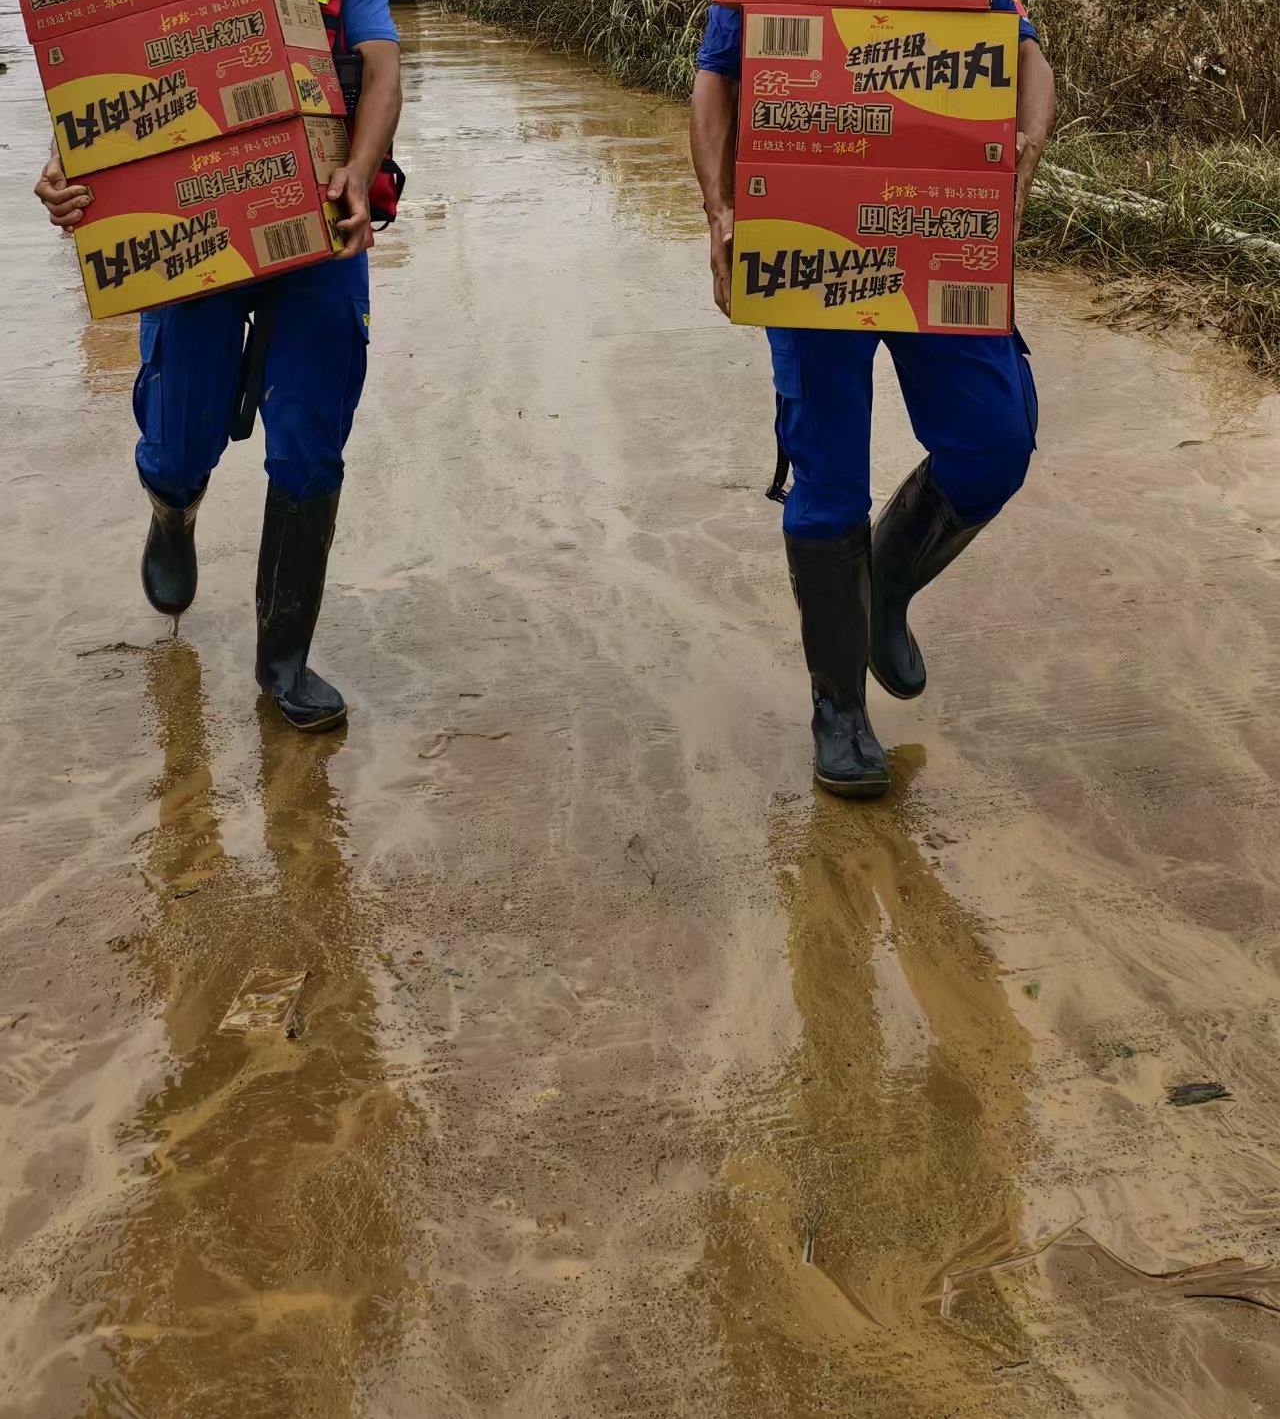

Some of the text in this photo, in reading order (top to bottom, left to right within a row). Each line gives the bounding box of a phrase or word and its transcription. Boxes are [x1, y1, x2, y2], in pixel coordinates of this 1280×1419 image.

[145, 11, 265, 68] 红烧牛肉面
[221, 41, 273, 71] 统一
[846, 32, 926, 67] 全新升级
[753, 70, 817, 96] 统一
[134, 85, 198, 140] 全新升级
[752, 102, 893, 135] 红烧牛肉面
[752, 139, 807, 152] 红烧这个味
[175, 149, 299, 208] 红烧牛肉面
[252, 181, 304, 210] 统一
[857, 204, 1000, 240] 红烧牛肉面
[165, 226, 229, 281] 全新升级
[937, 245, 1000, 270] 统一
[824, 271, 904, 308] 全新升级
